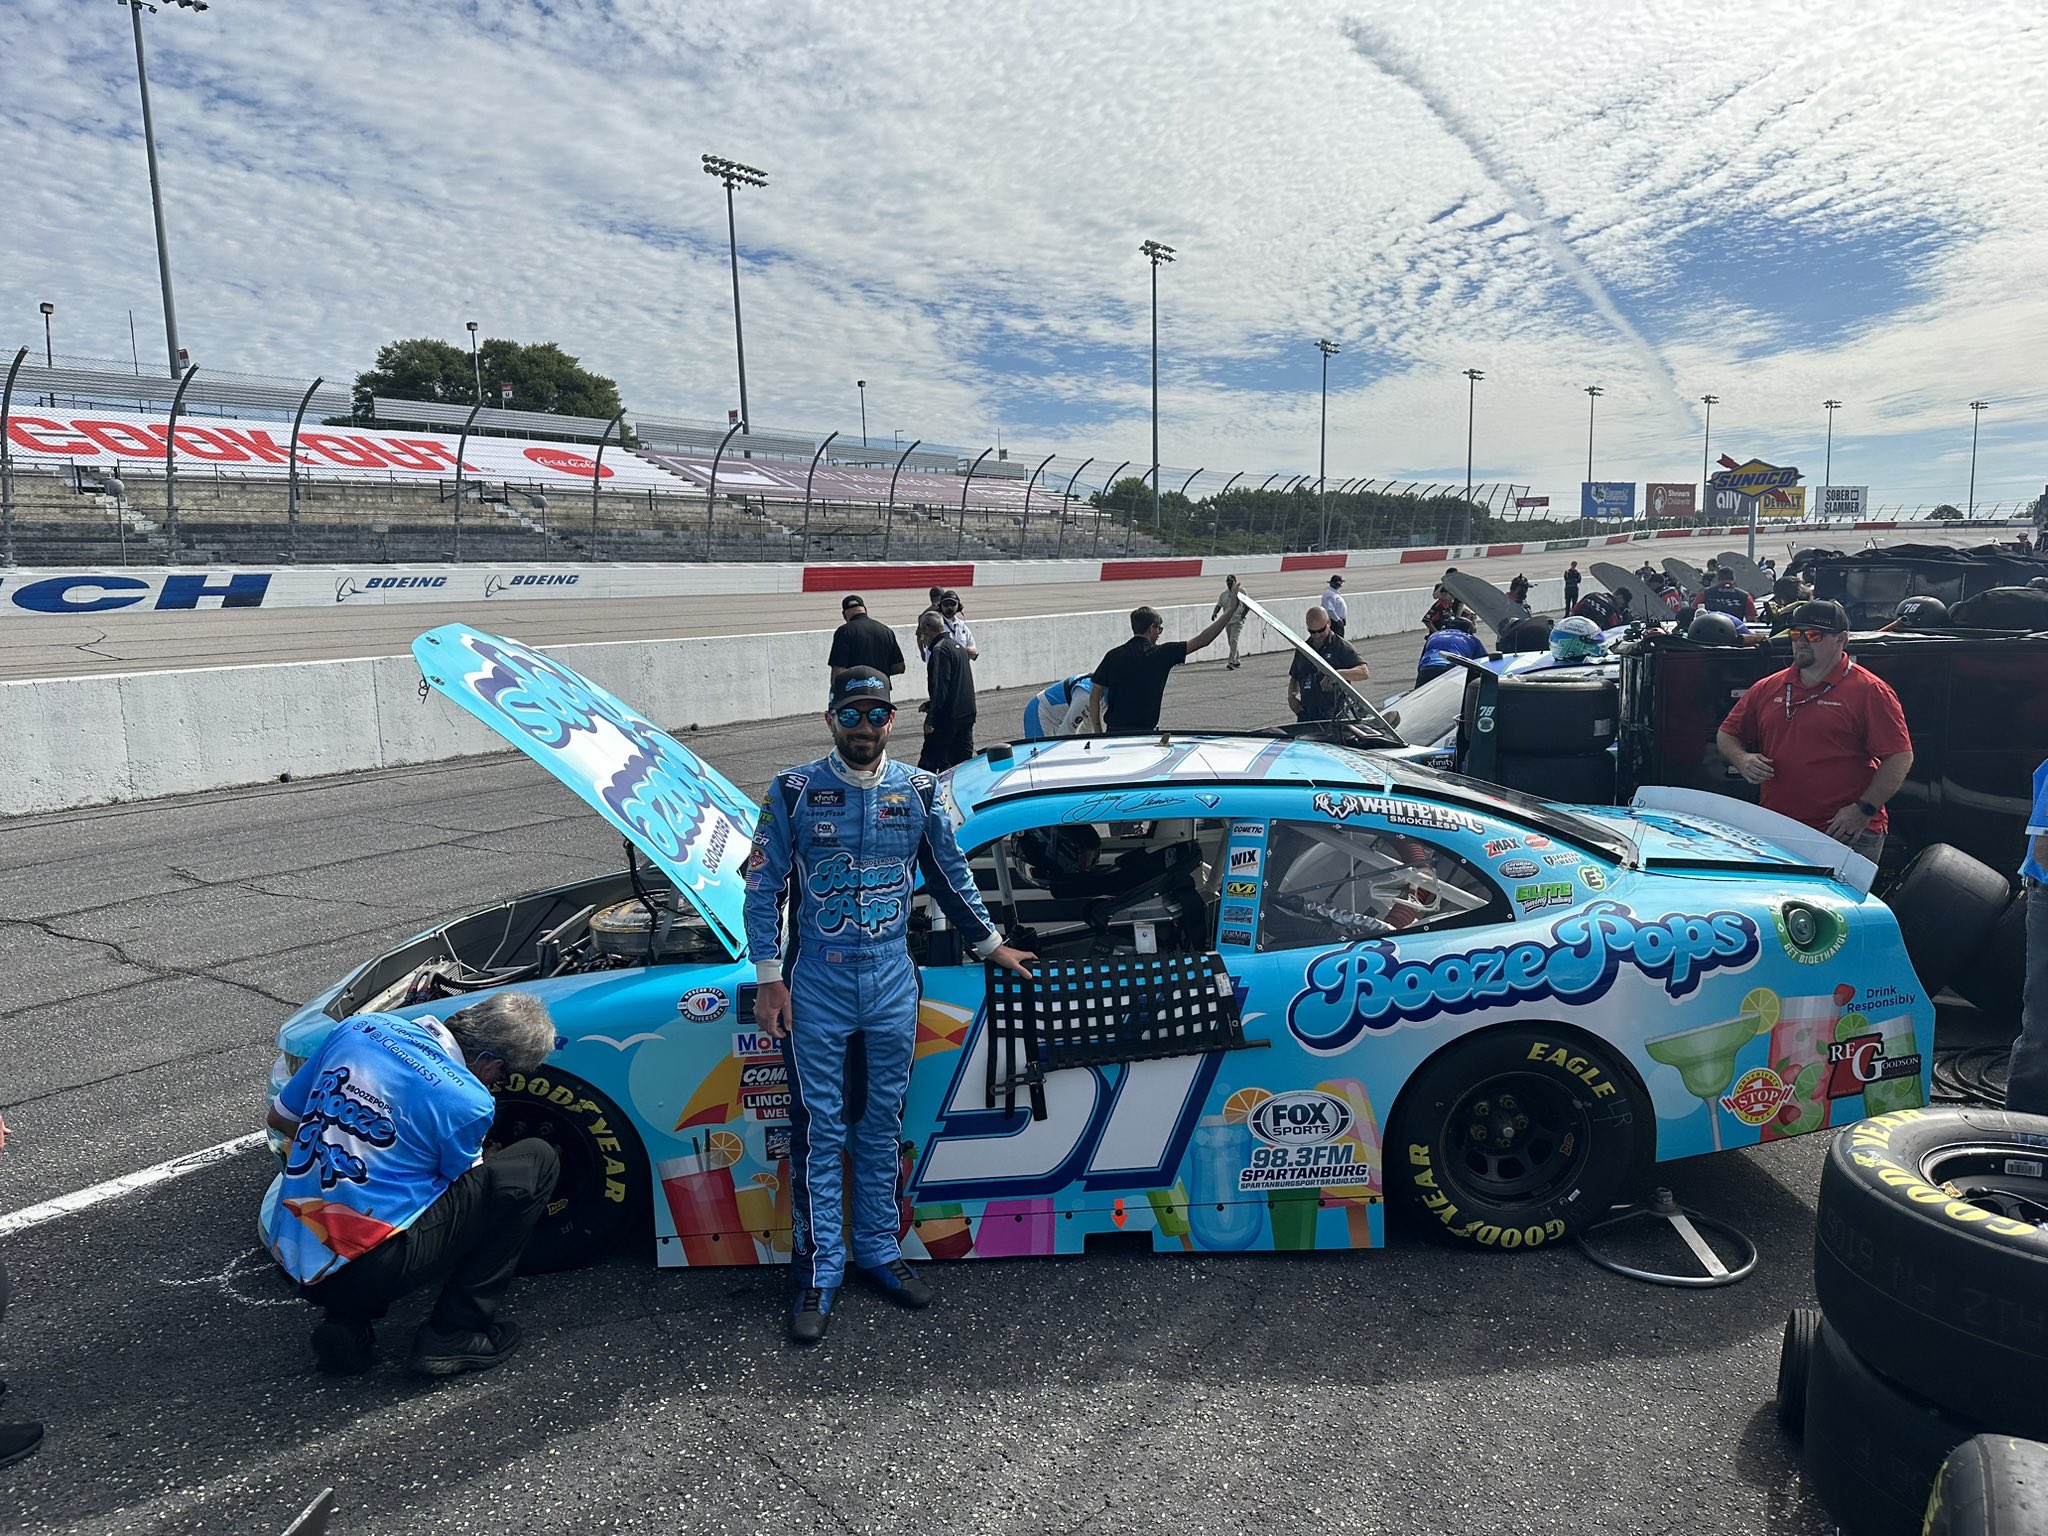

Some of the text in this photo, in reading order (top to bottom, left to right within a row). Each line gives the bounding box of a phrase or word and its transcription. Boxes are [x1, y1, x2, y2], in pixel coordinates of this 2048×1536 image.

[1717, 470, 1794, 488] SUNOCO
[1667, 489, 1690, 497] Shriners
[1826, 489, 1850, 501] SOBER
[1716, 490, 1741, 515] ally
[1824, 502, 1860, 513] SLAMMER
[365, 576, 448, 588] BOEING
[509, 574, 580, 585] BOEING
[0, 573, 273, 613] CH
[1903, 602, 1920, 613] 78
[1479, 705, 1496, 717] 78
[1426, 756, 1455, 770] xfinity
[813, 793, 839, 803] xfinity
[1357, 795, 1485, 834] WHITETAIL
[1389, 815, 1459, 831] SMOKELESS
[817, 823, 832, 831] FOX
[1233, 825, 1263, 835] COMETIC
[1231, 849, 1257, 867] WIX
[808, 852, 905, 898] Booze
[1516, 883, 1573, 902] ELITE
[816, 888, 900, 936] Pops
[1784, 933, 1847, 965] GET BIOETHANOL
[1290, 905, 1758, 1052] Booze Pops
[1866, 985, 1897, 999] Drink
[1846, 993, 1916, 1013] Responsibly
[1526, 1041, 1617, 1099] EAGLE
[910, 978, 1250, 1196] 51
[1738, 1089, 1780, 1109] STOP
[1272, 1102, 1329, 1127] FOX
[1272, 1124, 1331, 1136] SPORTS
[1252, 1144, 1354, 1169] 98.3FM
[1241, 1164, 1368, 1182] SPARTANBURG
[1852, 1108, 2039, 1237] GOODYEAR
[1240, 1177, 1368, 1190] SPARTANBURGSPORTSRADIO.COM
[1408, 1142, 1567, 1249] GOODYEAR
